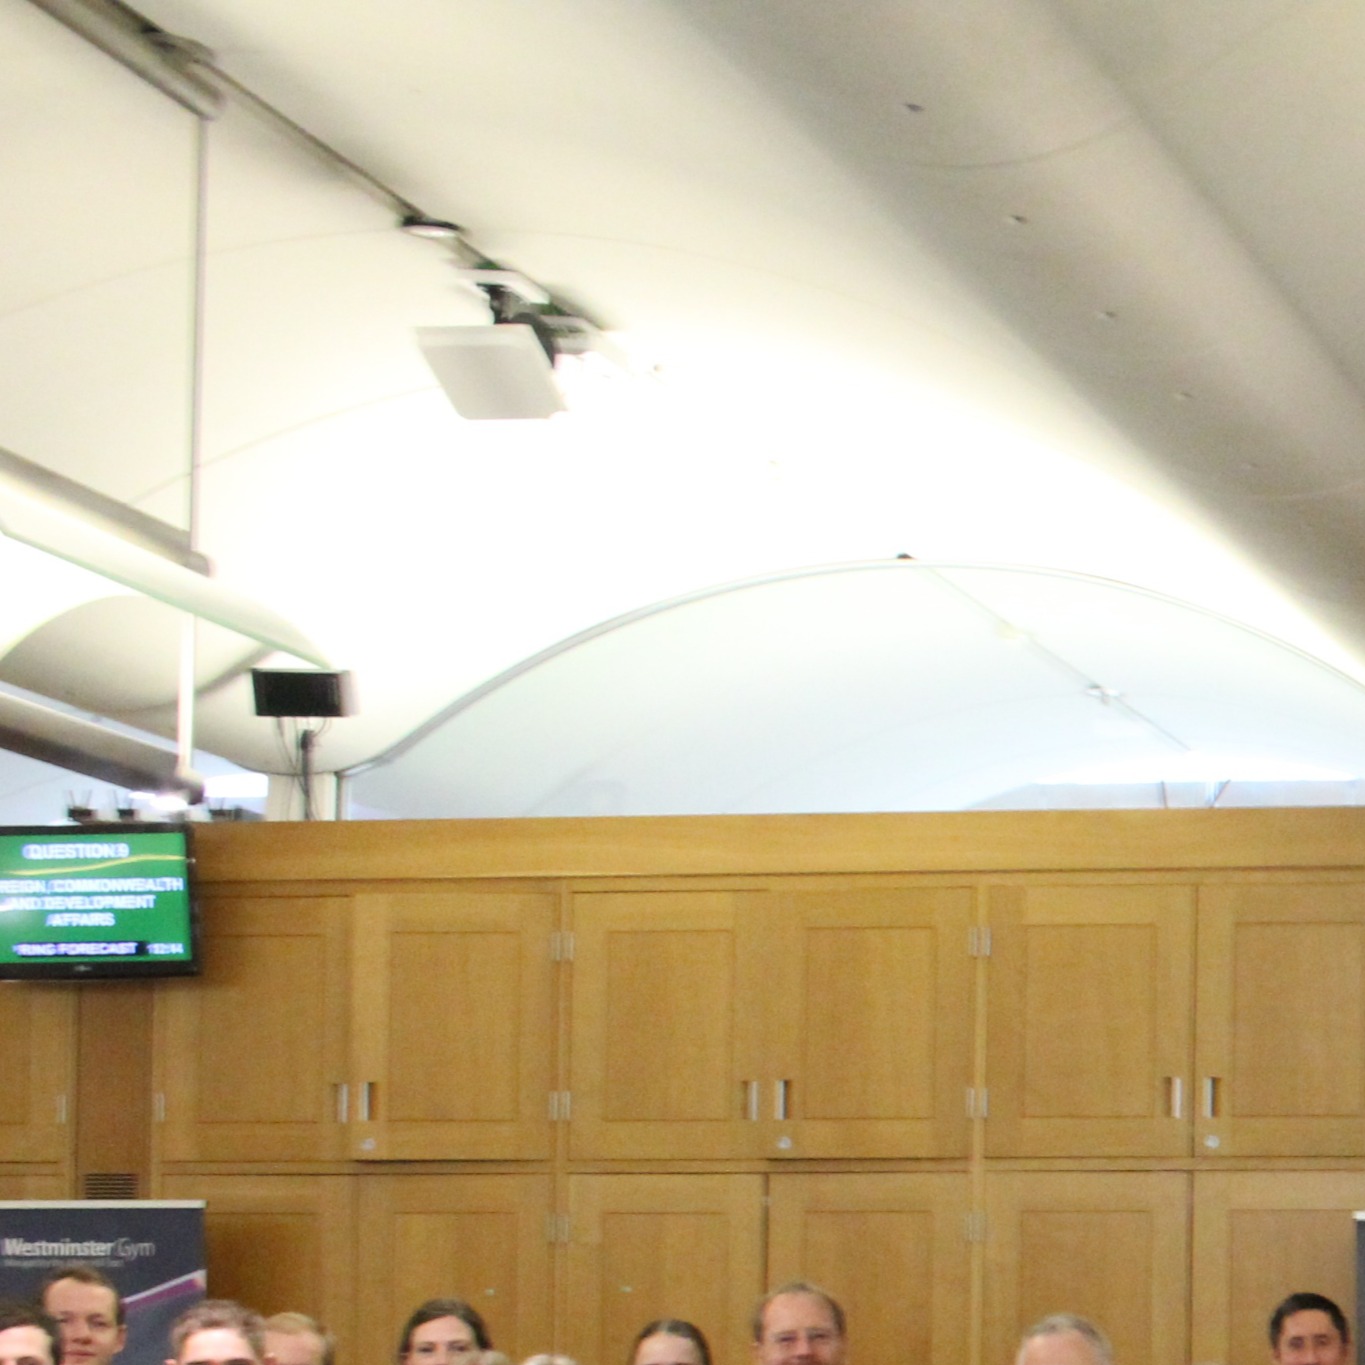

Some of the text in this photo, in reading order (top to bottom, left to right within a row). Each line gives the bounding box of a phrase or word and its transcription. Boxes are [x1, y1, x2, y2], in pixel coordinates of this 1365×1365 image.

[22, 843, 114, 859] QUESTION
[50, 877, 183, 892] COMMONWEALTH
[43, 894, 156, 909] DEVELOPMENT
[46, 912, 115, 927] AFFAIRS
[57, 942, 137, 956] FORECAST
[3, 1238, 156, 1261] Westminster Gym
